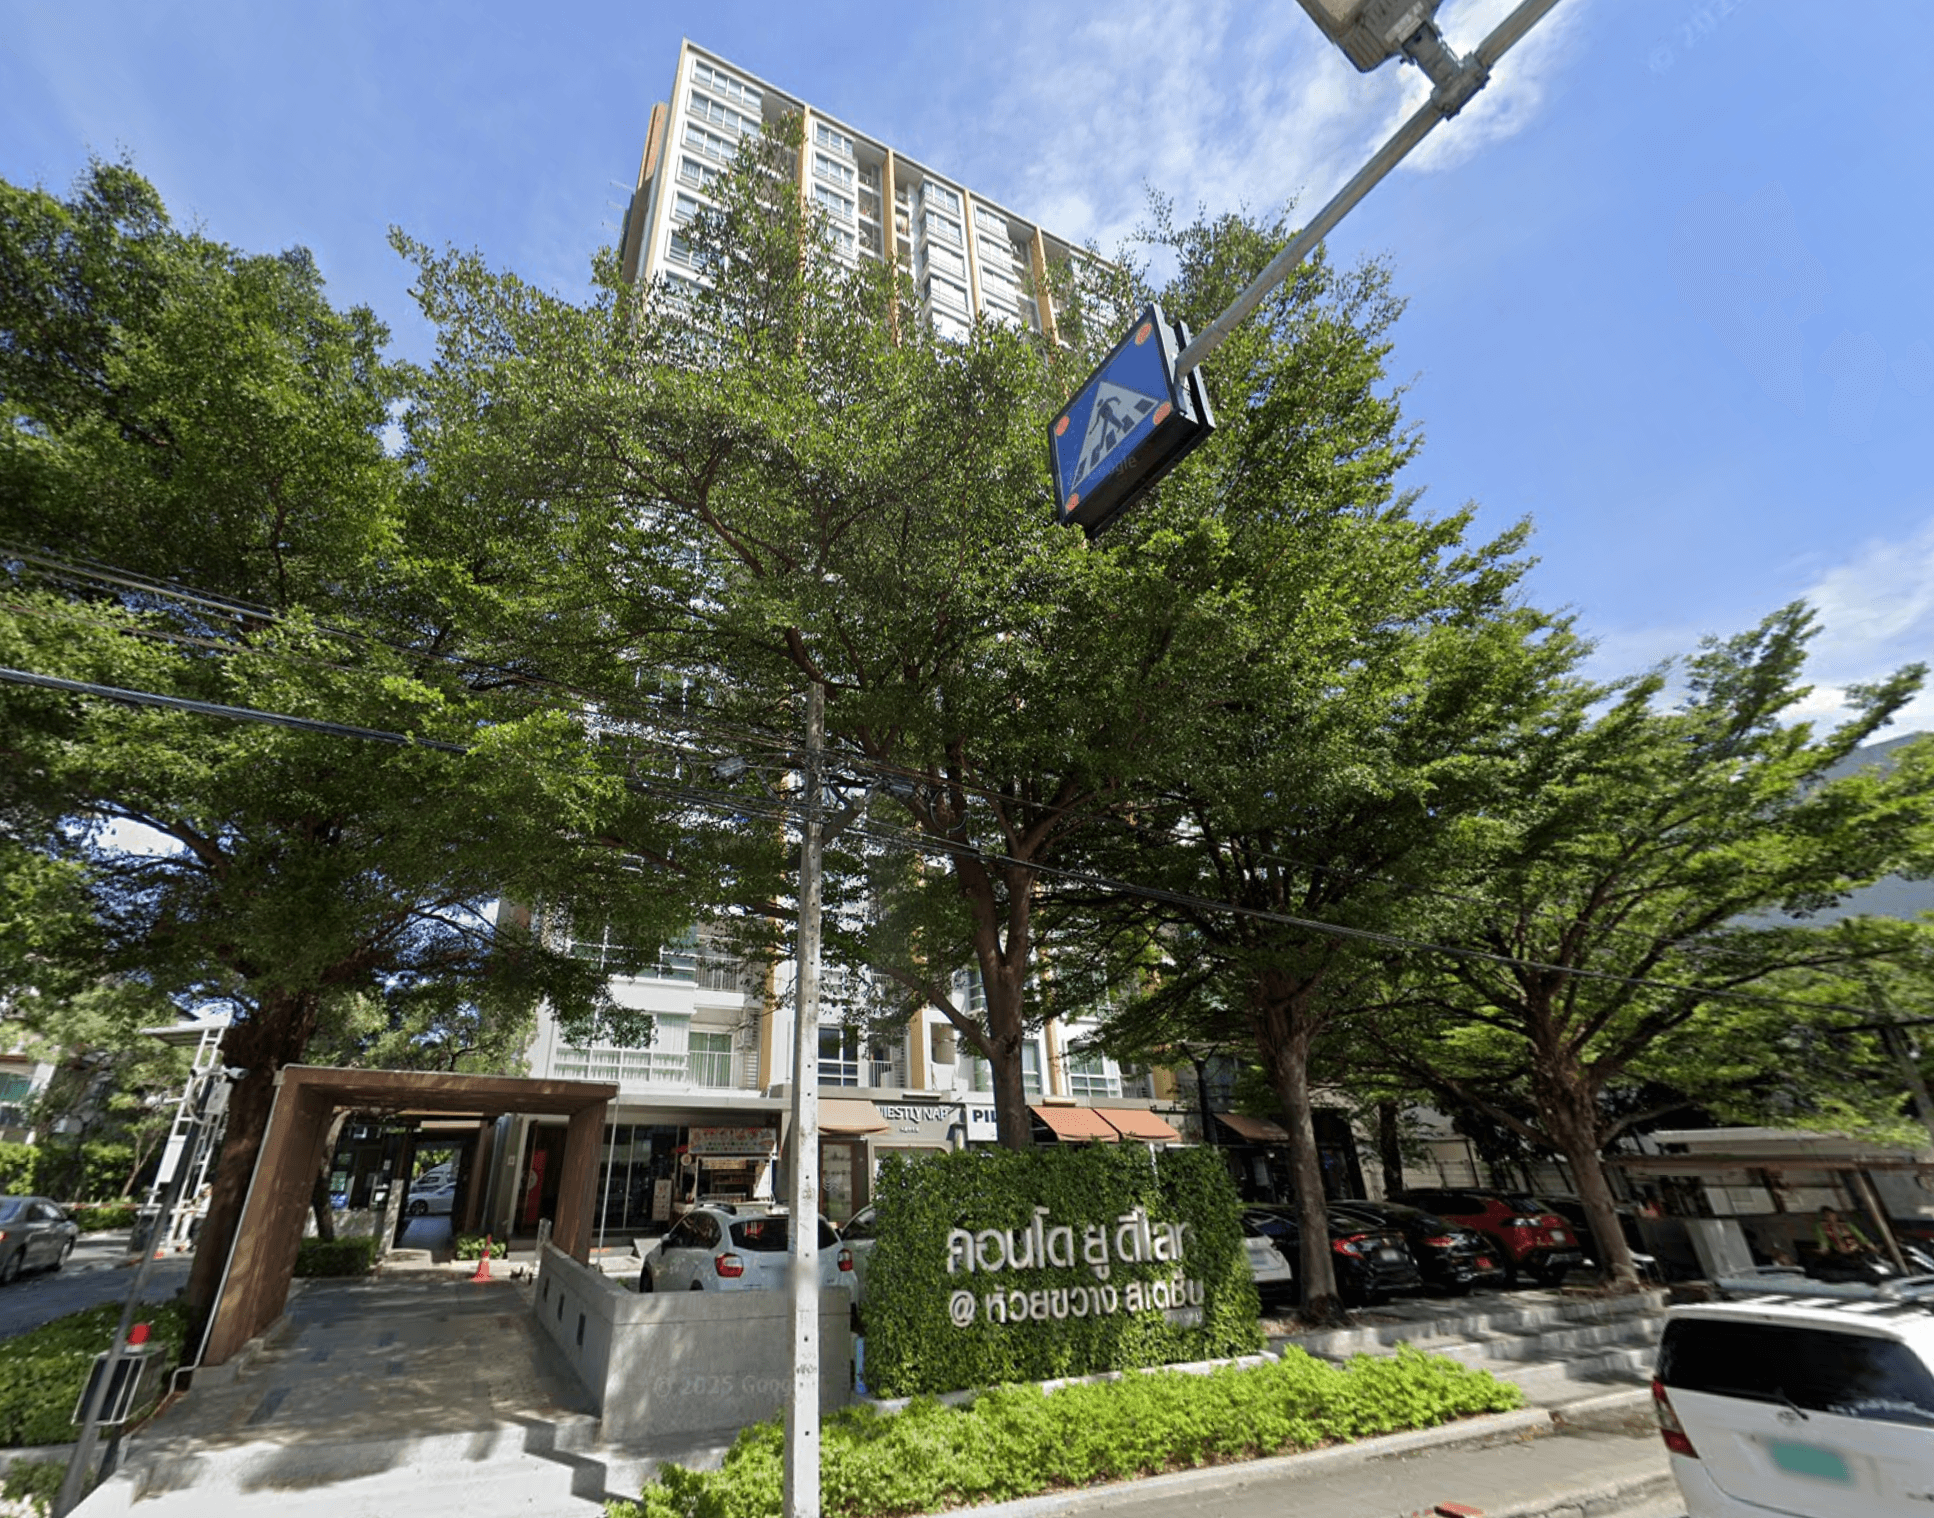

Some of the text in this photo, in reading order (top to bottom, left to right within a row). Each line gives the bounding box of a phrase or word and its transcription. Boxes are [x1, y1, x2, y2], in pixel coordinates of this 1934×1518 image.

[947, 1205, 1075, 1273] คอนโด
[1083, 1224, 1111, 1280] ยู
[950, 1290, 976, 1328] @
[986, 1284, 1118, 1324] ห้วยขวาง
